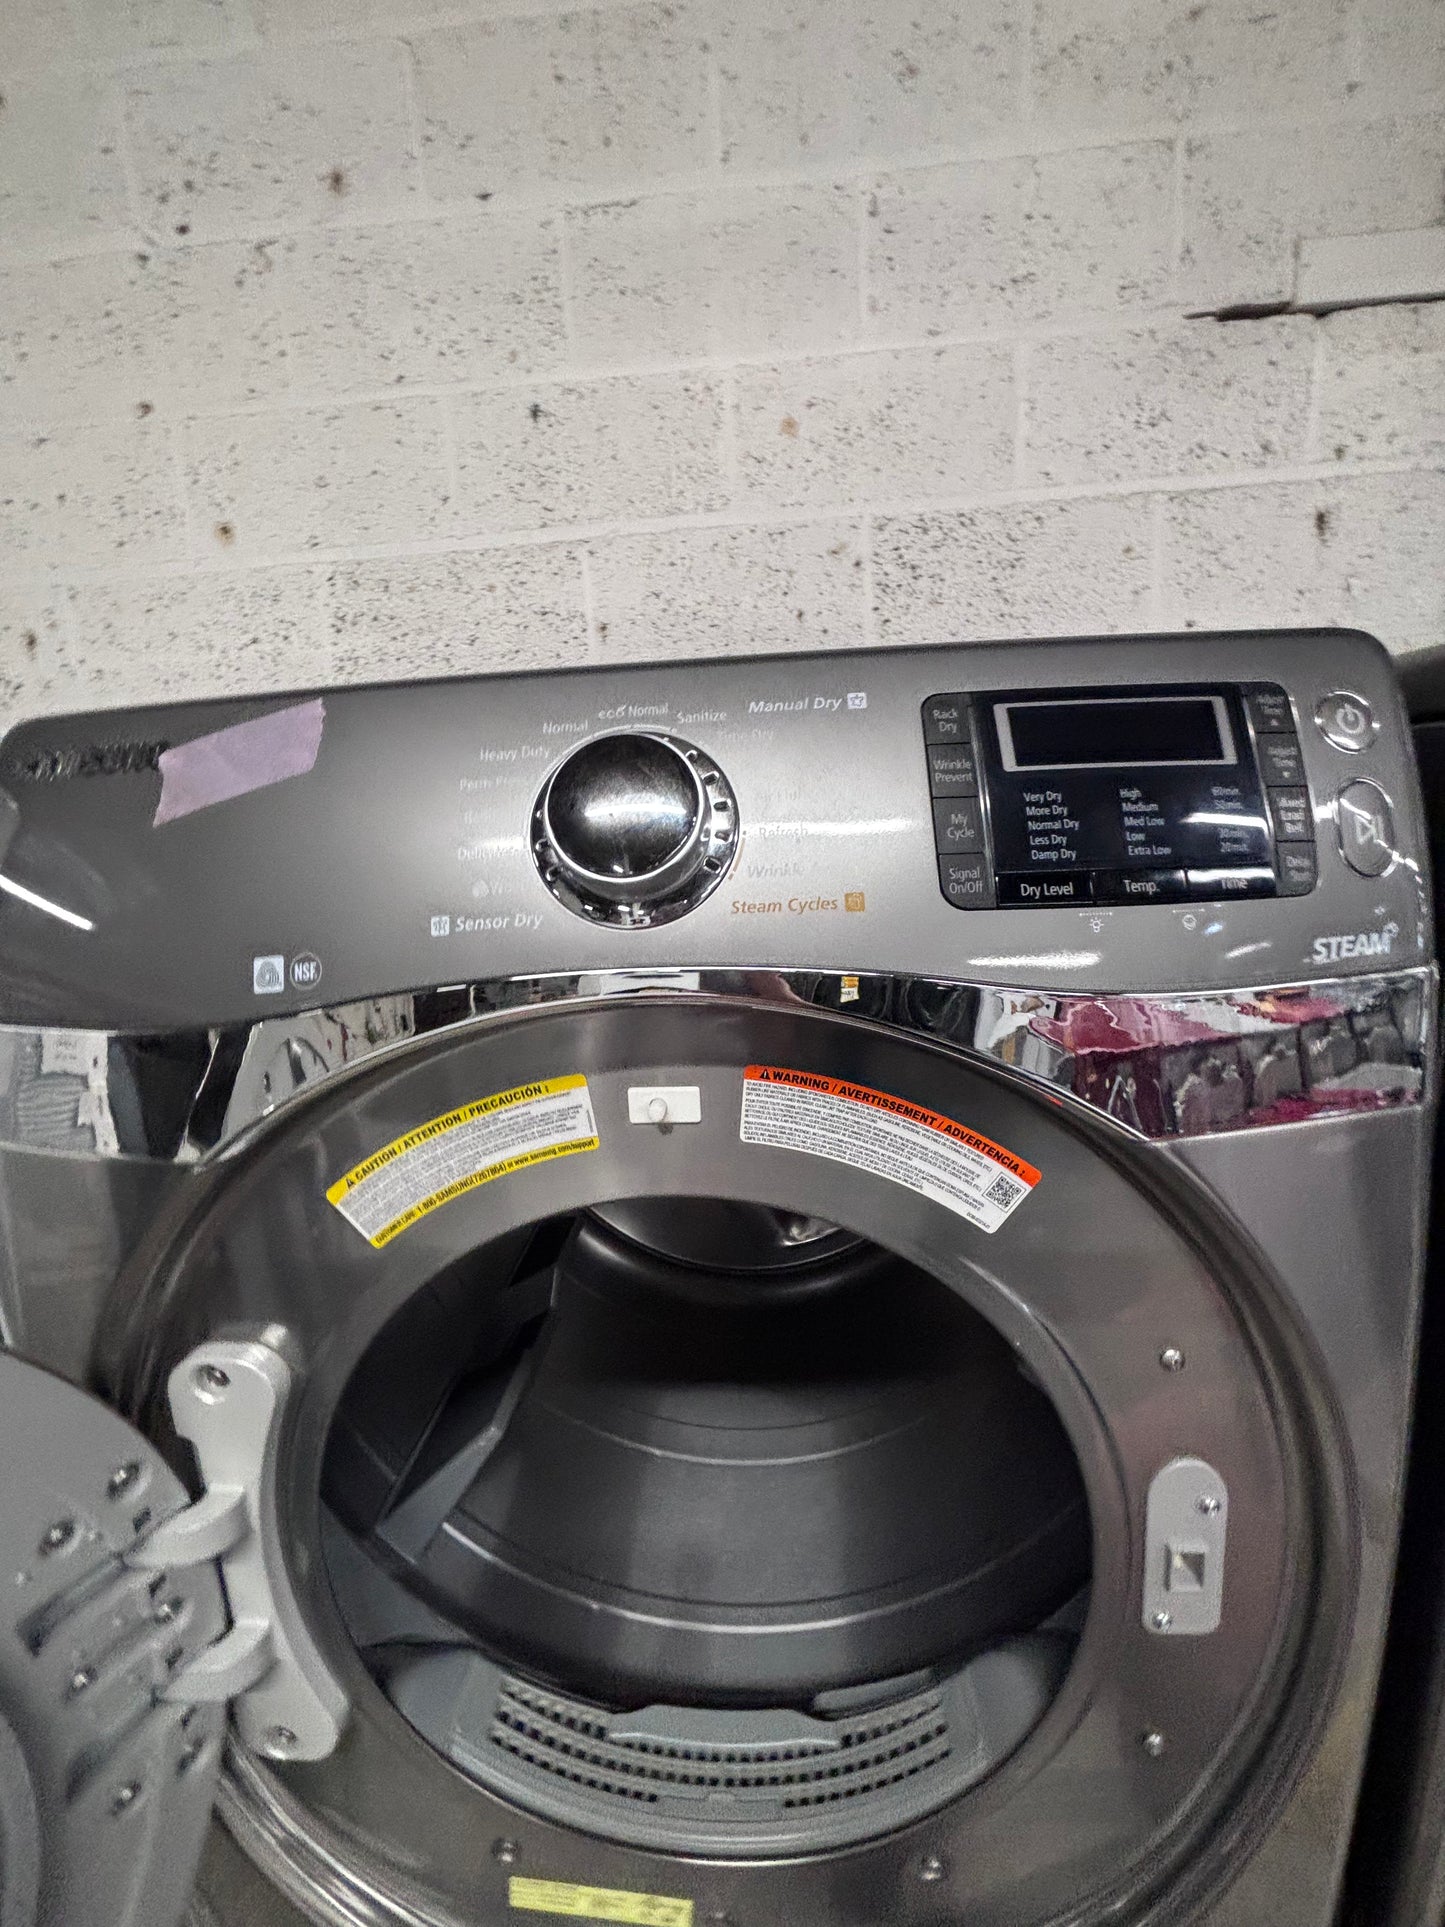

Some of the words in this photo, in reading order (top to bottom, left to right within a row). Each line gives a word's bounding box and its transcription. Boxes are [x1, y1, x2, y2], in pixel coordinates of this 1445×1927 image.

[628, 702, 669, 718] Normal
[748, 697, 809, 713] Manual
[813, 697, 843, 712] Dry
[676, 709, 728, 724] Sanitize
[542, 719, 588, 735] Normal
[939, 721, 957, 733] Dry
[480, 747, 518, 761] Heavy
[521, 745, 550, 759] Duty
[933, 758, 972, 770] Wrinkle
[935, 771, 974, 782] Prevent
[1023, 792, 1043, 803] Very
[1046, 791, 1062, 803] Dry
[1026, 806, 1051, 816] More
[1052, 805, 1068, 816] Dry
[951, 813, 968, 826] My
[1028, 820, 1062, 831] Normal
[1063, 819, 1080, 831] Dry
[947, 826, 975, 840] Cycle
[1030, 835, 1050, 846] Less
[1051, 834, 1067, 847] Dry
[1031, 849, 1059, 861] Damp
[1060, 848, 1077, 861] Dry
[949, 866, 980, 882] Signal
[949, 880, 983, 894] On/Off
[1020, 883, 1041, 899] Dry
[1043, 882, 1074, 896] Level
[1123, 880, 1160, 895] Temp.
[730, 899, 782, 914] Steam
[787, 896, 839, 915] Cycles
[455, 915, 510, 932] Sensor
[514, 913, 544, 930] Dry
[1312, 932, 1391, 964] STEAM
[772, 1071, 829, 1091] WARNING
[838, 1086, 938, 1126] AVERTISSEMENT
[944, 1124, 1020, 1173] ADVERTENCIA
[355, 1148, 398, 1180] CAUTION
[403, 1113, 462, 1149] ATTENTION
[468, 1085, 542, 1117] PRECAUCIÓN
